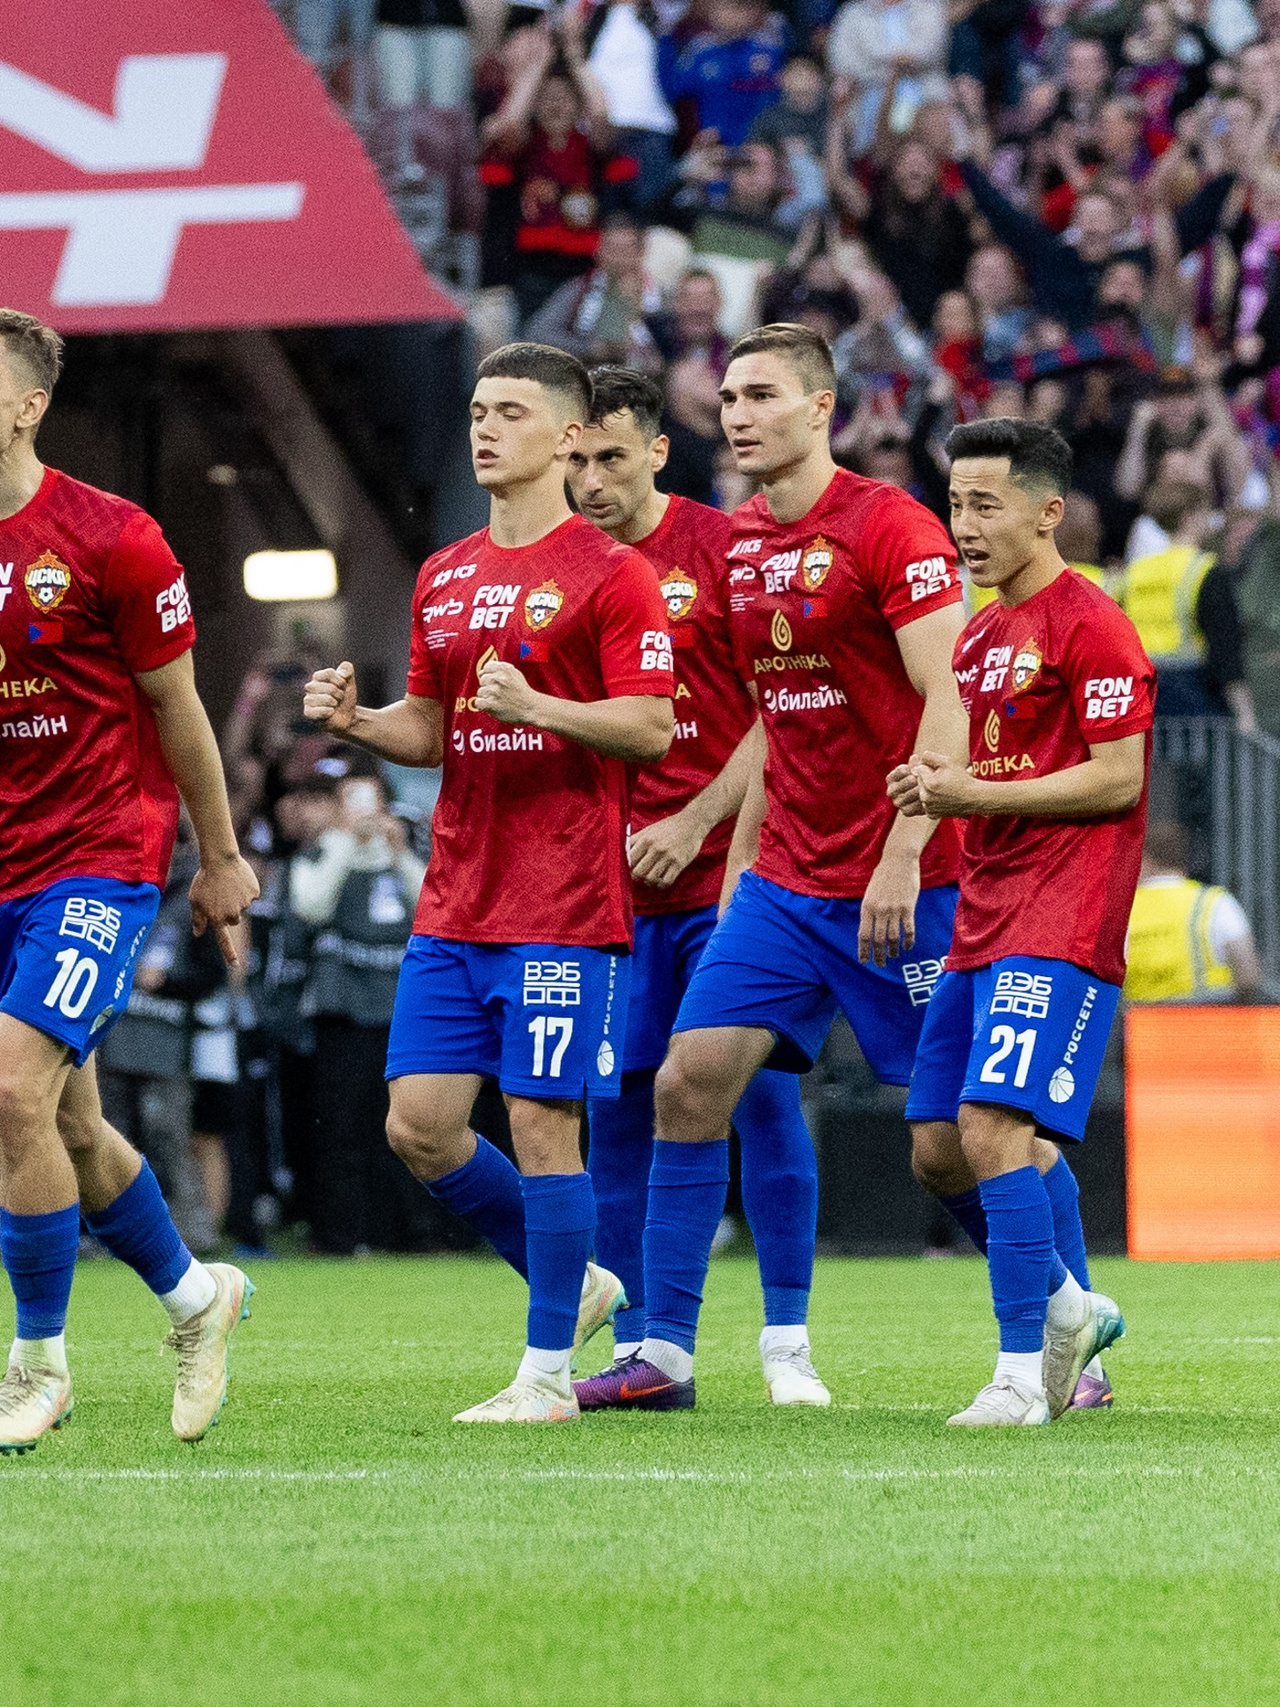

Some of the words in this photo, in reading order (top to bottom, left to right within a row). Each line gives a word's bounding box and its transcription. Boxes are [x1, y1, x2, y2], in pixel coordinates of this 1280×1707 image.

[760, 549, 802, 571] FON
[905, 557, 947, 582] FON
[156, 573, 187, 613] FON
[764, 570, 797, 593] BET
[911, 573, 951, 601] BET
[472, 585, 521, 606] FON
[161, 594, 191, 633] BET
[469, 606, 515, 629] BET
[778, 685, 848, 711] билайн
[1084, 677, 1133, 699] FON
[1086, 696, 1133, 719] BET
[65, 898, 121, 930] ВЭБ
[43, 947, 99, 1018] 10
[524, 961, 580, 981] ВЭБ
[996, 971, 1053, 995] ВЭБ
[1063, 986, 1098, 1064] РОССЕТИ
[528, 1016, 573, 1077] 17
[979, 1025, 1037, 1088] 21
